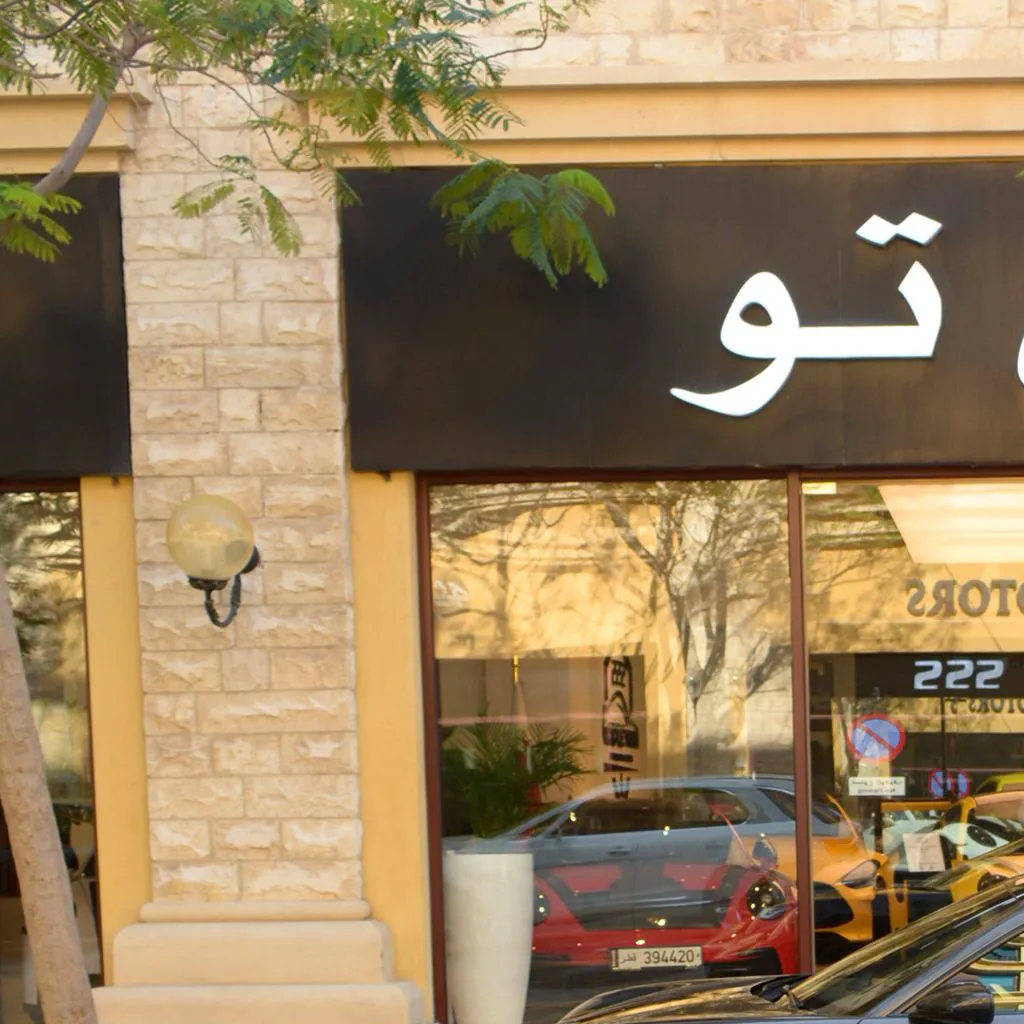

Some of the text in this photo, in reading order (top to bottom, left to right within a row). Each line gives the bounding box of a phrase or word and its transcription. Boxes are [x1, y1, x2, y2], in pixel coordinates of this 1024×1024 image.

[669, 210, 943, 417] تو
[914, 659, 1004, 690] 222
[643, 949, 695, 965] 394420
